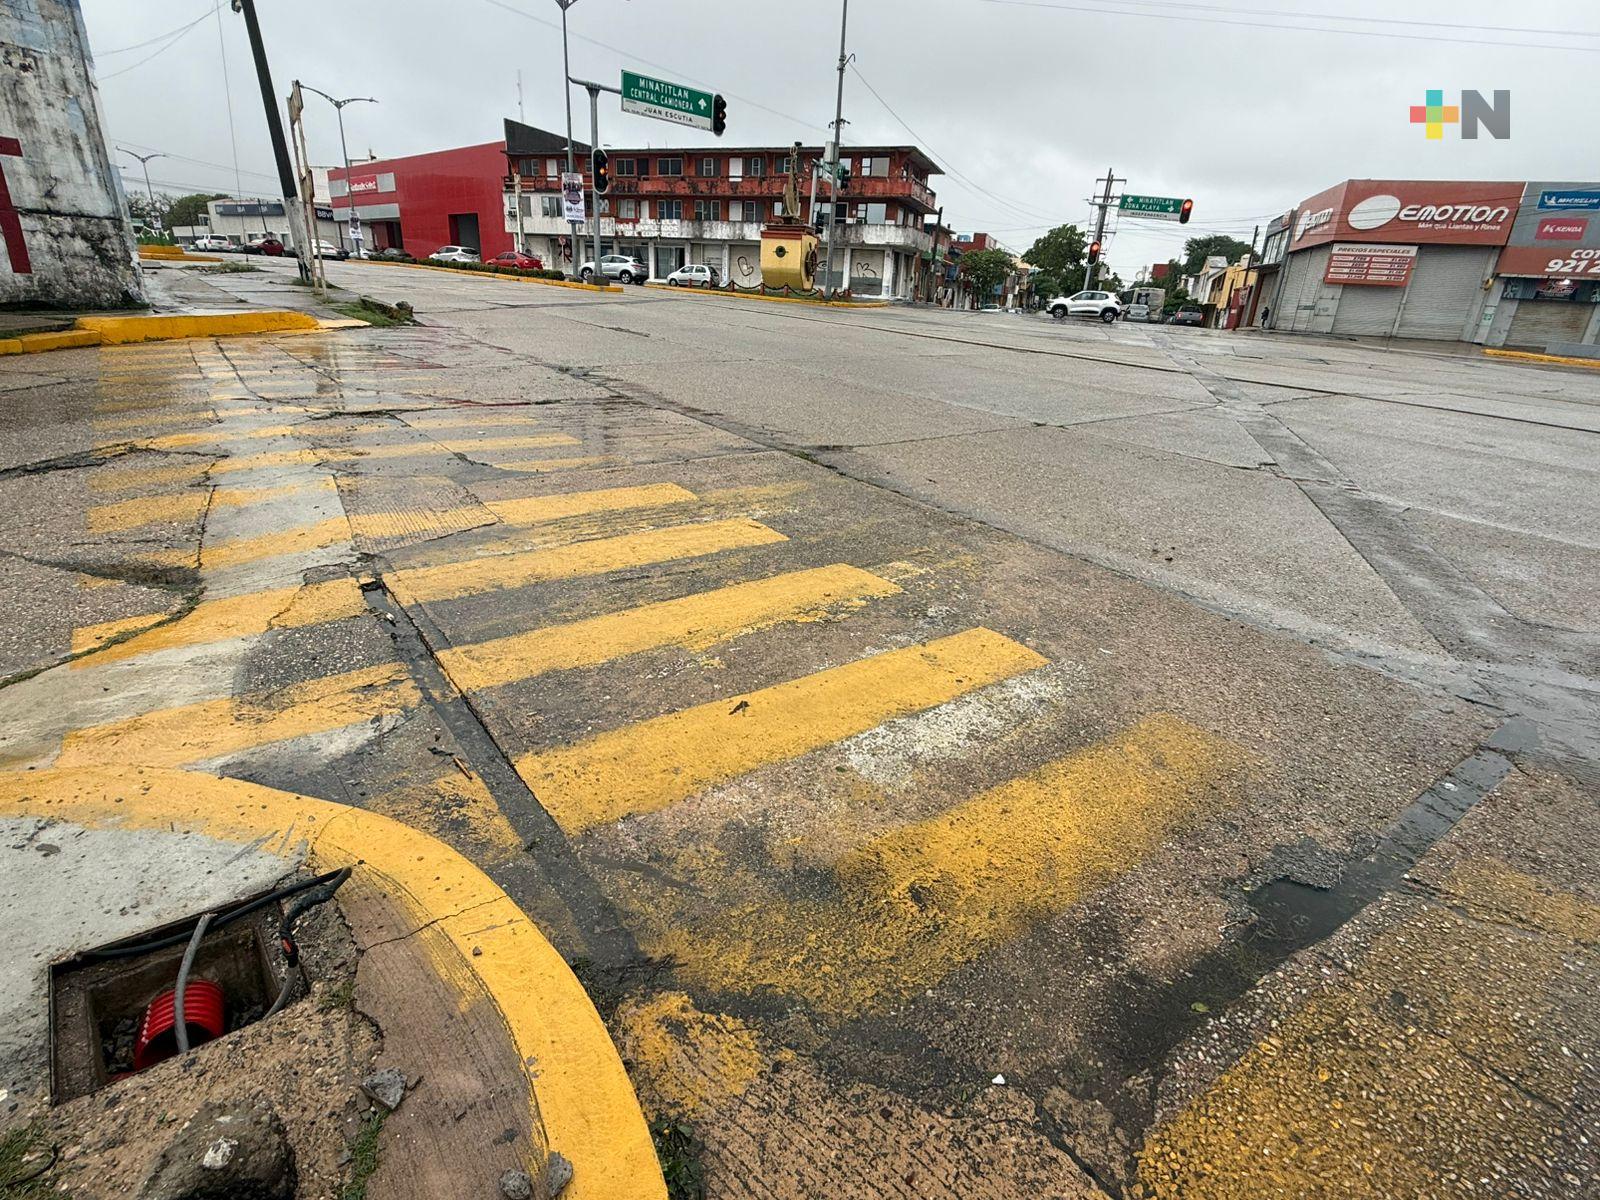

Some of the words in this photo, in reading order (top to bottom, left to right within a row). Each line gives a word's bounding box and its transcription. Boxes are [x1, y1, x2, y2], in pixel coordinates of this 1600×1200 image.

[639, 78, 689, 99] MINATITLAN
[630, 88, 658, 102] CENTRAL
[660, 95, 694, 112] CAMIONERA
[644, 106, 663, 116] JUAN
[665, 111, 693, 123] ESCUTIA
[1139, 197, 1174, 205] MINATITLAN
[1398, 204, 1509, 223] EMOTION
[1544, 258, 1589, 273] 921
